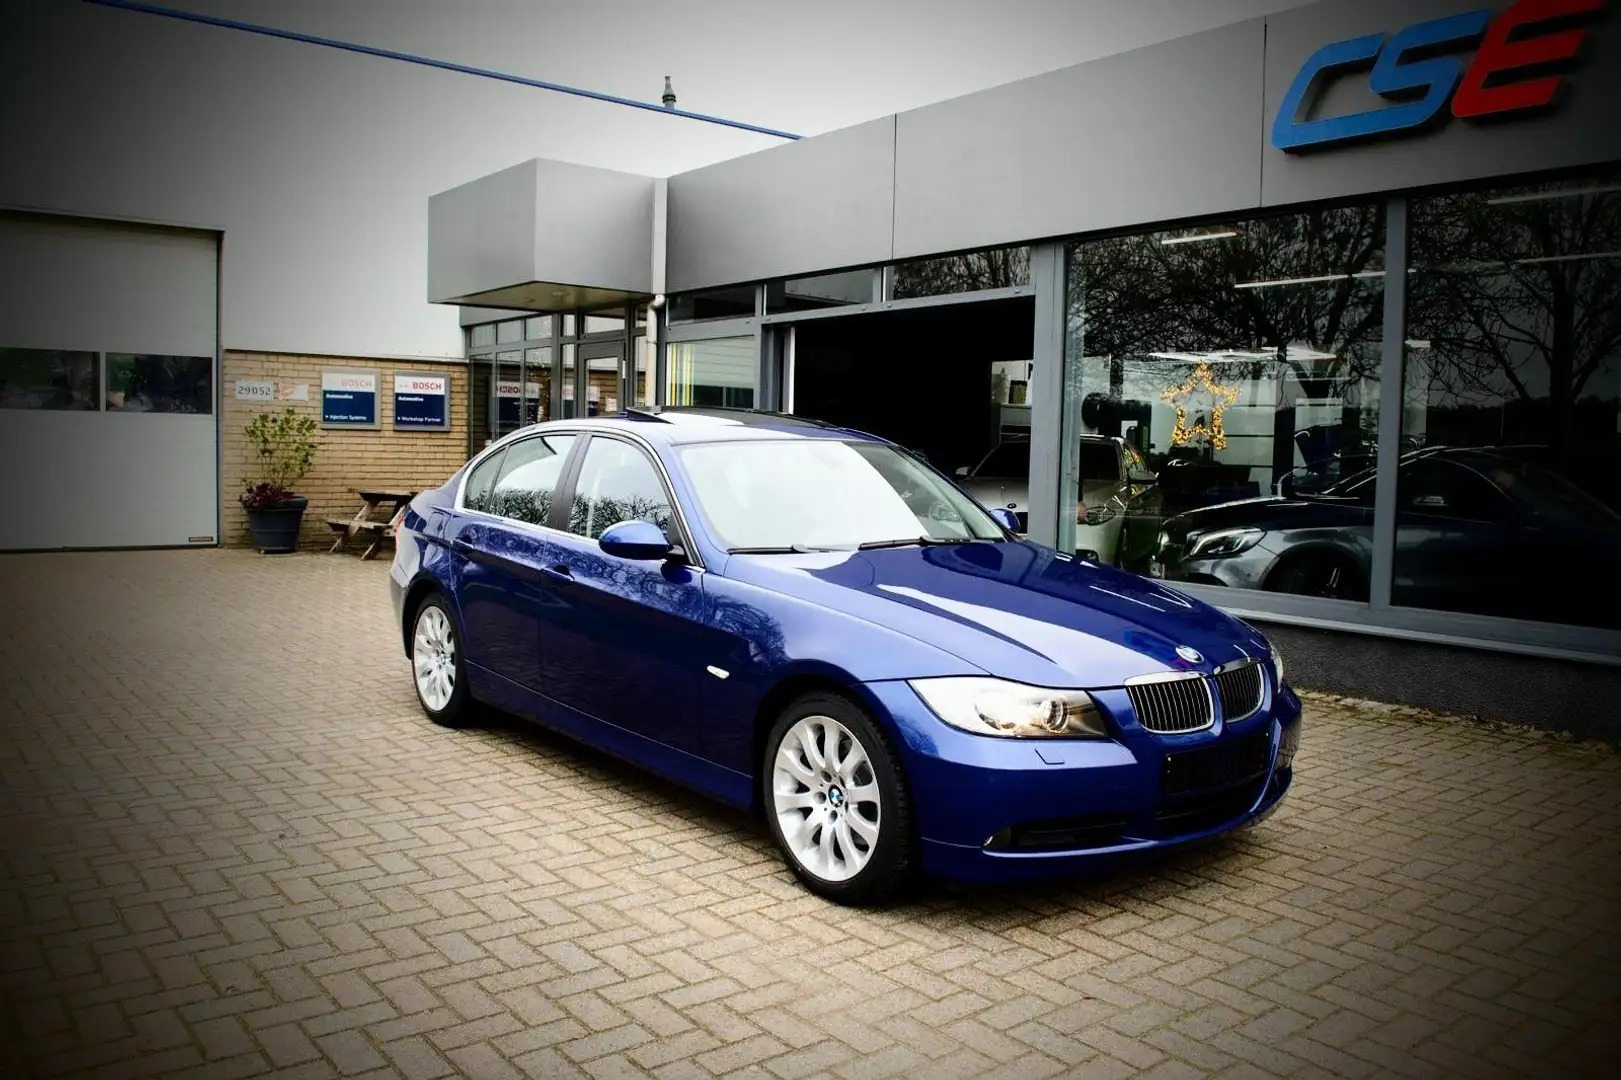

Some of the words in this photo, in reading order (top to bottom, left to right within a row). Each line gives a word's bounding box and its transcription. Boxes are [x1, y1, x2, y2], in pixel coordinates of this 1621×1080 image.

[1272, 0, 1603, 150] CSE
[341, 379, 372, 387] BOSCH
[412, 382, 442, 390] BOSCH
[238, 386, 271, 396] 29052
